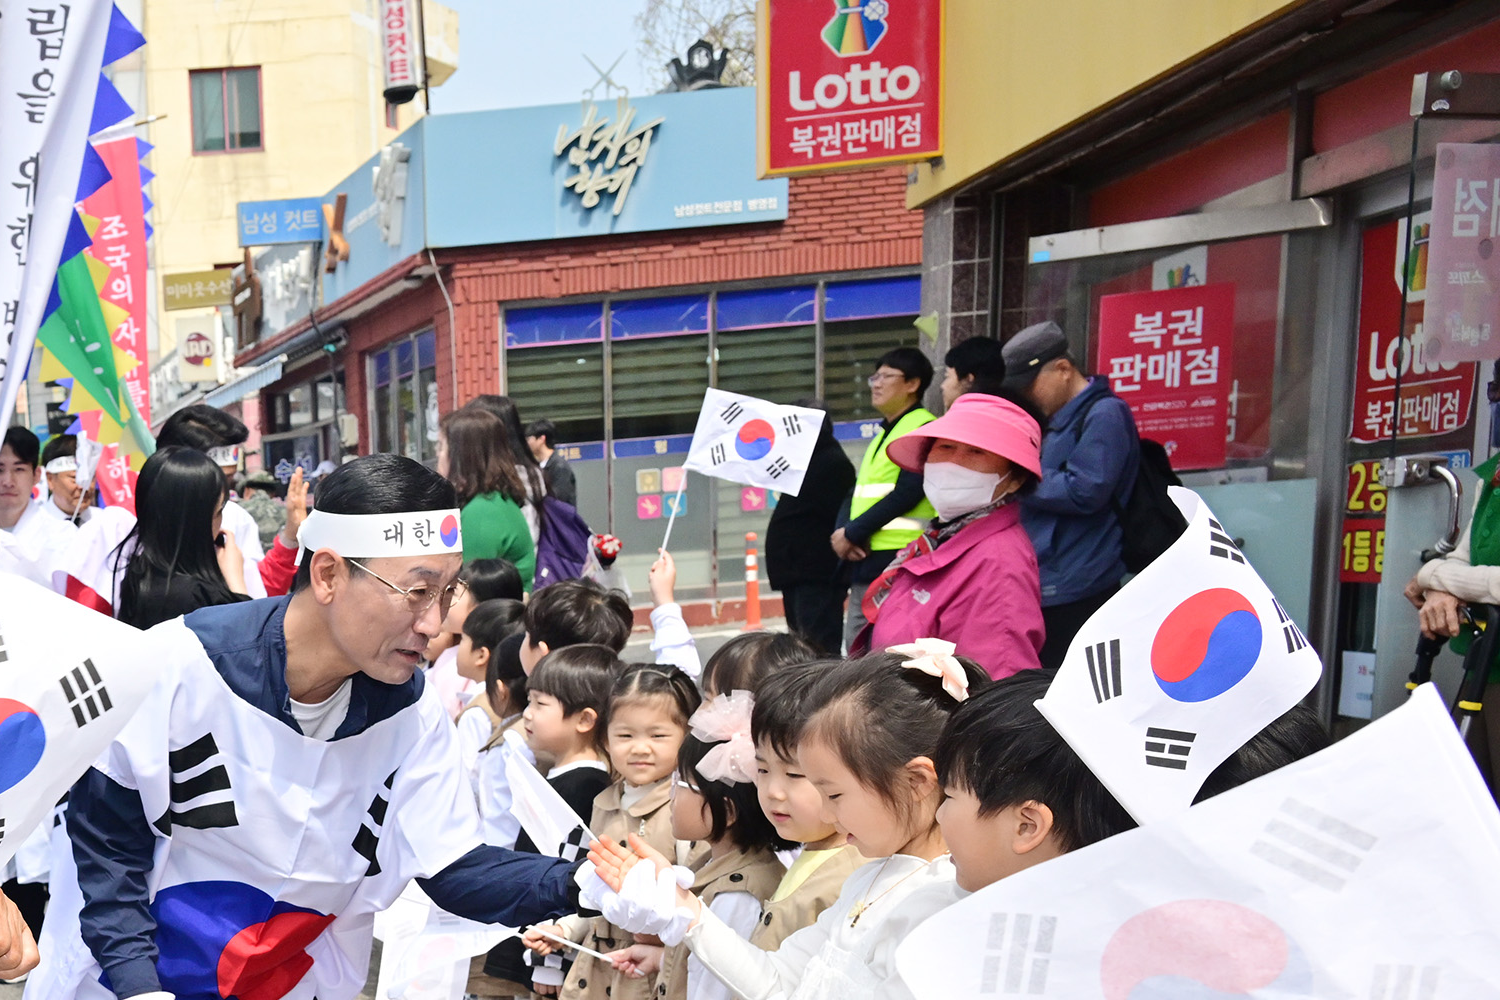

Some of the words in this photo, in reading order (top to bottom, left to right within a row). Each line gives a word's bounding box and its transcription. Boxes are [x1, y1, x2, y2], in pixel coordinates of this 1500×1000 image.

[789, 61, 921, 111] Lotto
[789, 112, 921, 159] 복권판매점
[242, 211, 278, 235] 남성
[284, 208, 320, 231] 컷트
[100, 214, 133, 305] 조국의
[1128, 306, 1204, 350] 복권
[1108, 345, 1220, 393] 판매점
[1364, 389, 1460, 438] 복권판매점
[383, 518, 436, 549] 대한
